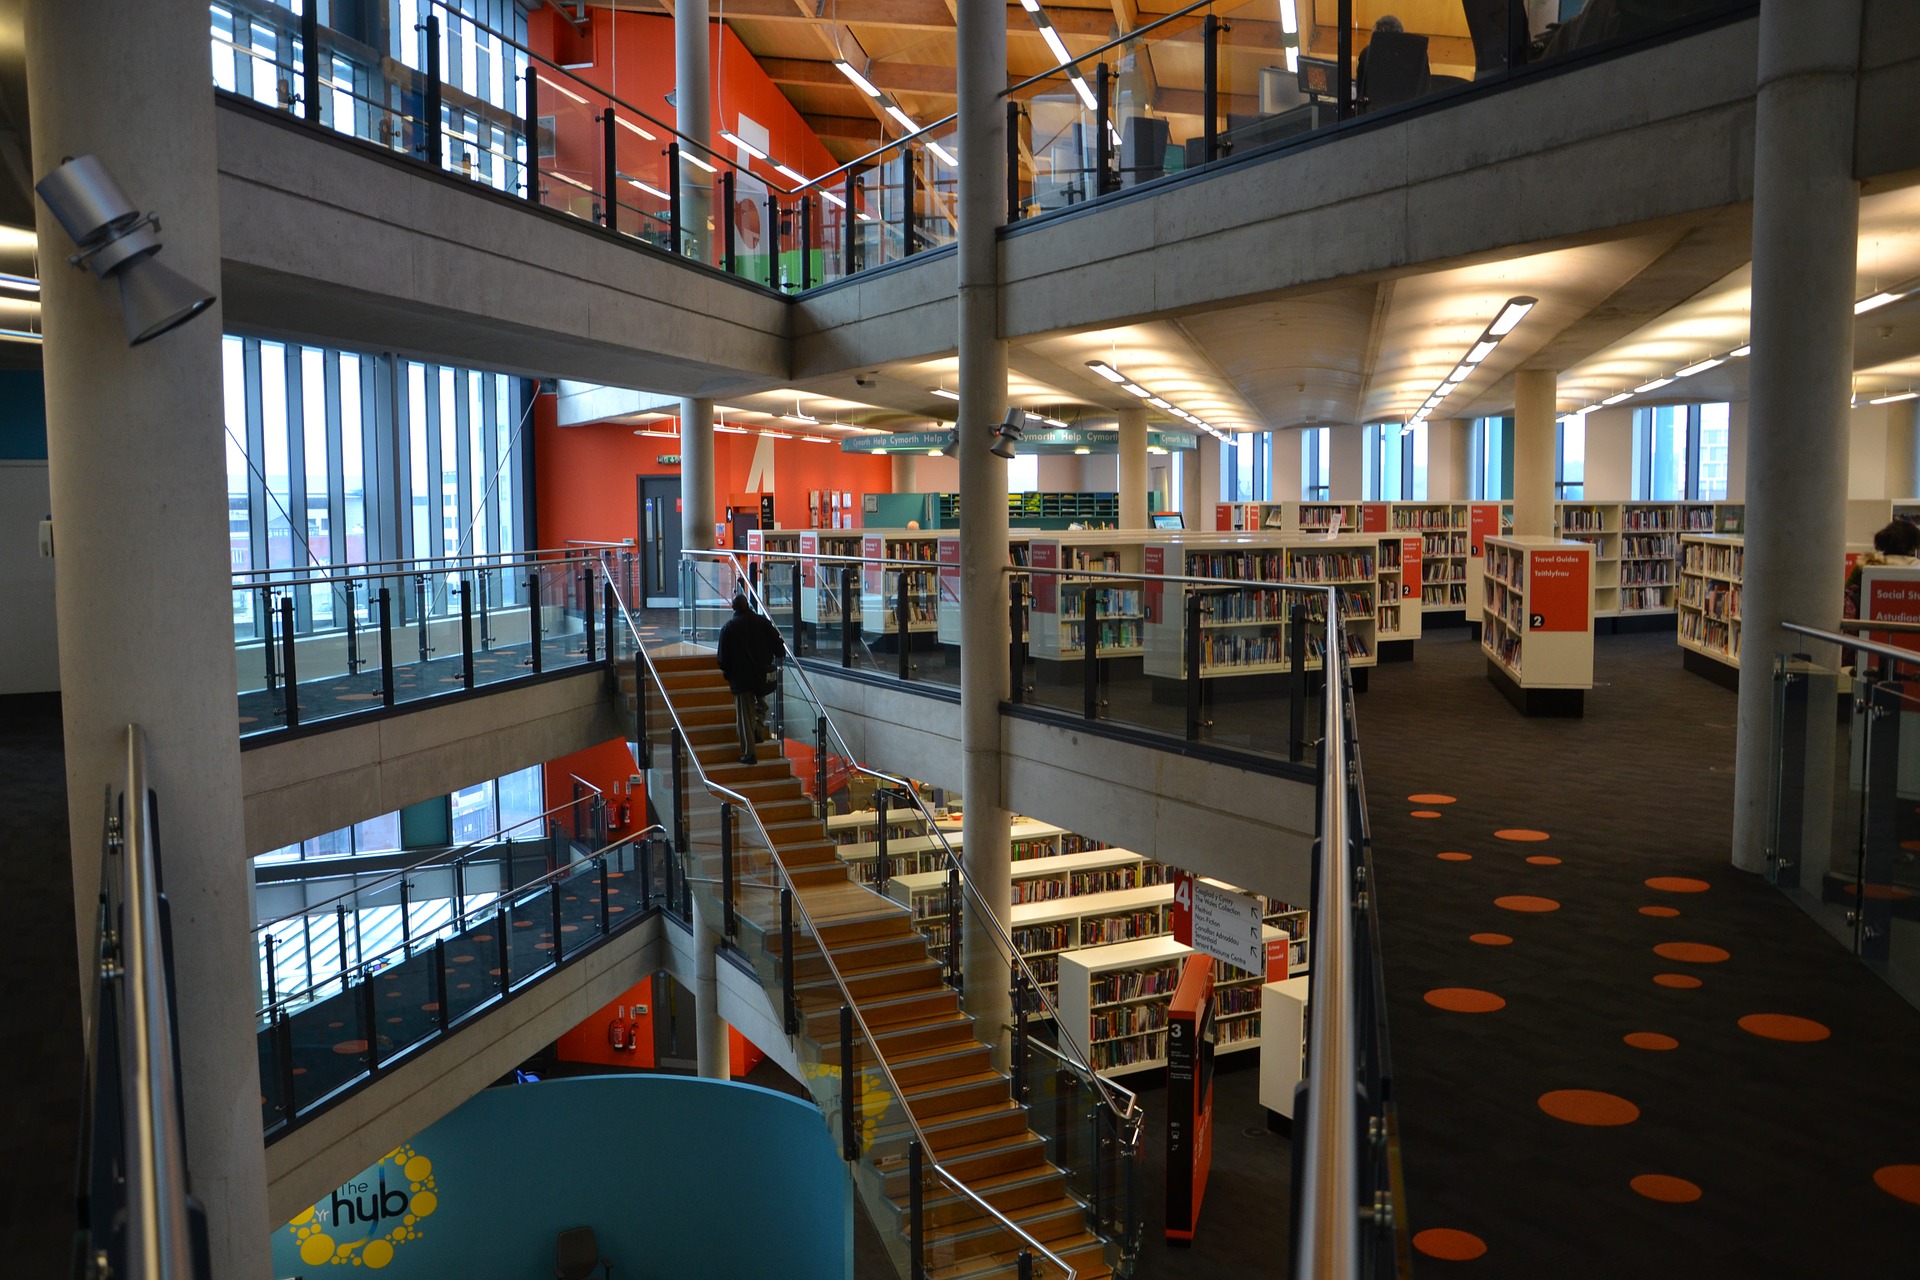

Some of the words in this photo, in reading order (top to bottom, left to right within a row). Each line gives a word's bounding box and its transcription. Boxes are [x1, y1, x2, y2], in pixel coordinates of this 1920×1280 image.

[873, 437, 887, 446] Help
[890, 435, 919, 445] Cymorth
[924, 434, 942, 444] Help
[1018, 432, 1056, 442] Cymorth
[1061, 432, 1082, 442] Help
[762, 498, 768, 506] 4
[1535, 570, 1570, 578] Teithlyfrau
[1404, 586, 1409, 595] 2
[1876, 589, 1905, 600] Social
[1533, 615, 1542, 627] 2
[1175, 880, 1191, 912] 4
[1195, 895, 1204, 903] The
[1204, 898, 1218, 909] Wales
[1218, 903, 1241, 916] Collection
[1210, 945, 1230, 959] Resource
[1230, 953, 1247, 965] Centre
[1171, 1023, 1182, 1038] 3
[315, 1209, 330, 1223] Yr
